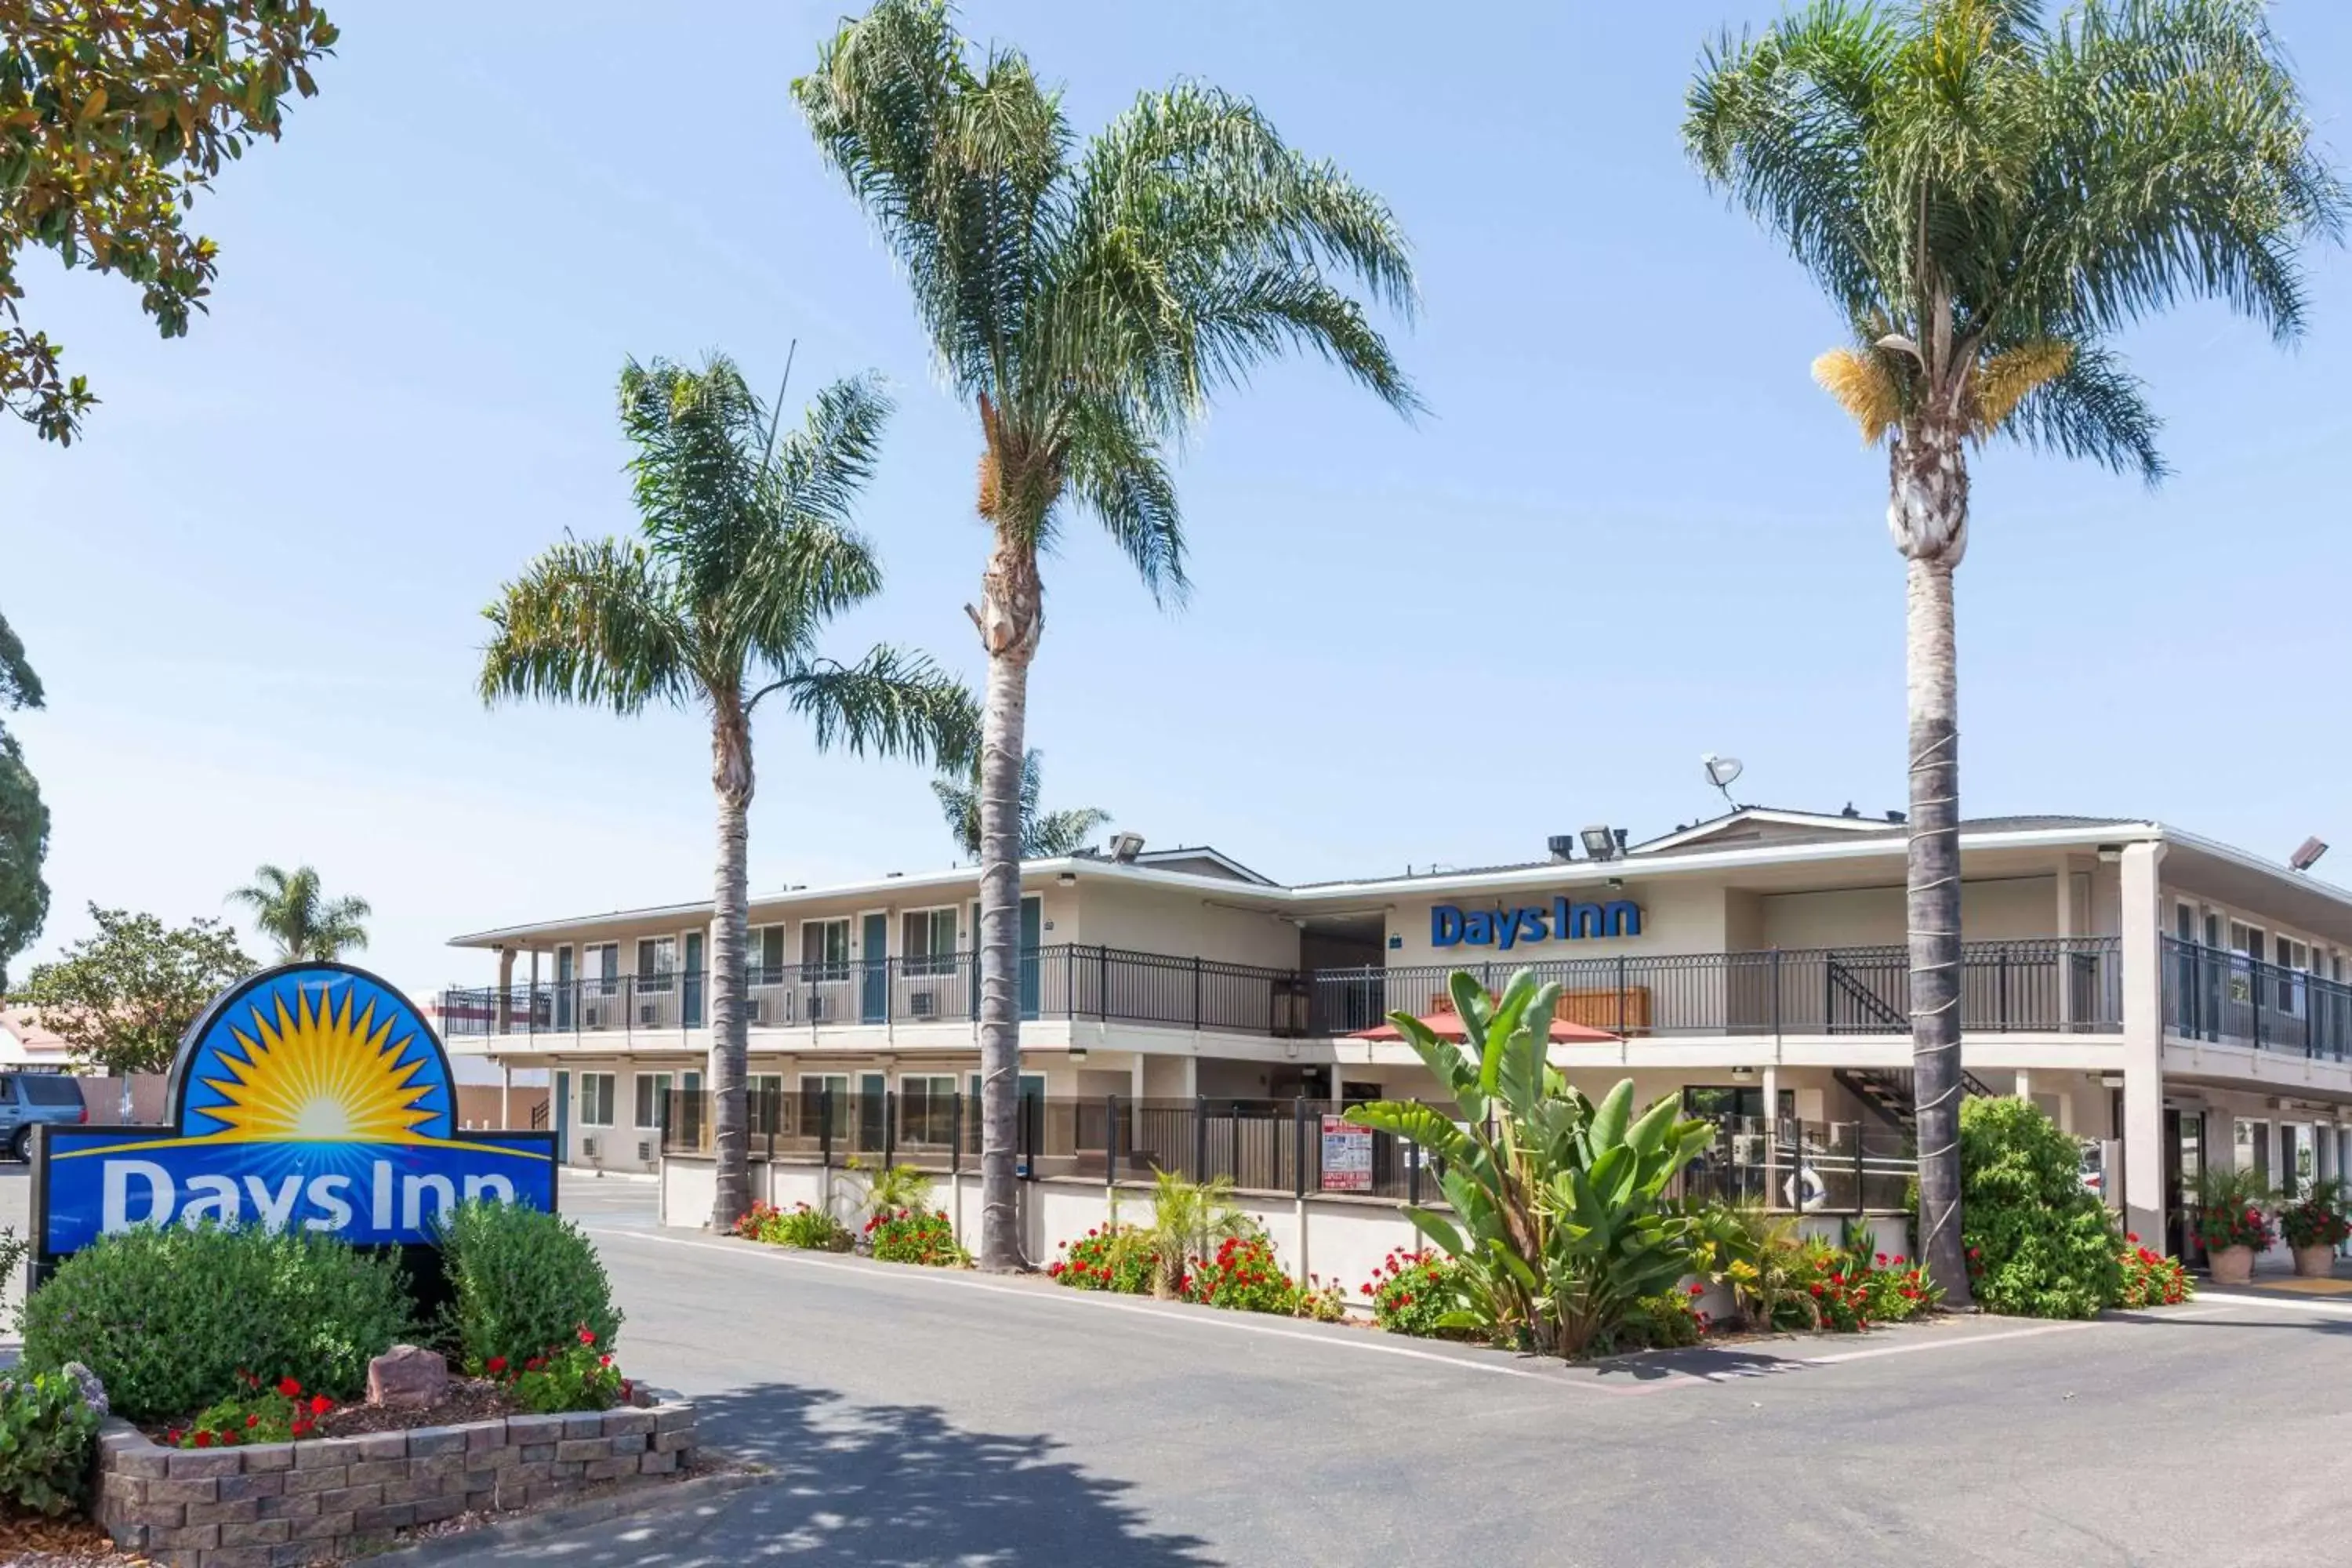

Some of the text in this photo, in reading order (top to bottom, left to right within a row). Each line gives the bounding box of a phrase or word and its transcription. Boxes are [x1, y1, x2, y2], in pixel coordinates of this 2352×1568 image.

[1431, 895, 1642, 950] Days Inn
[103, 1160, 353, 1240] Days
